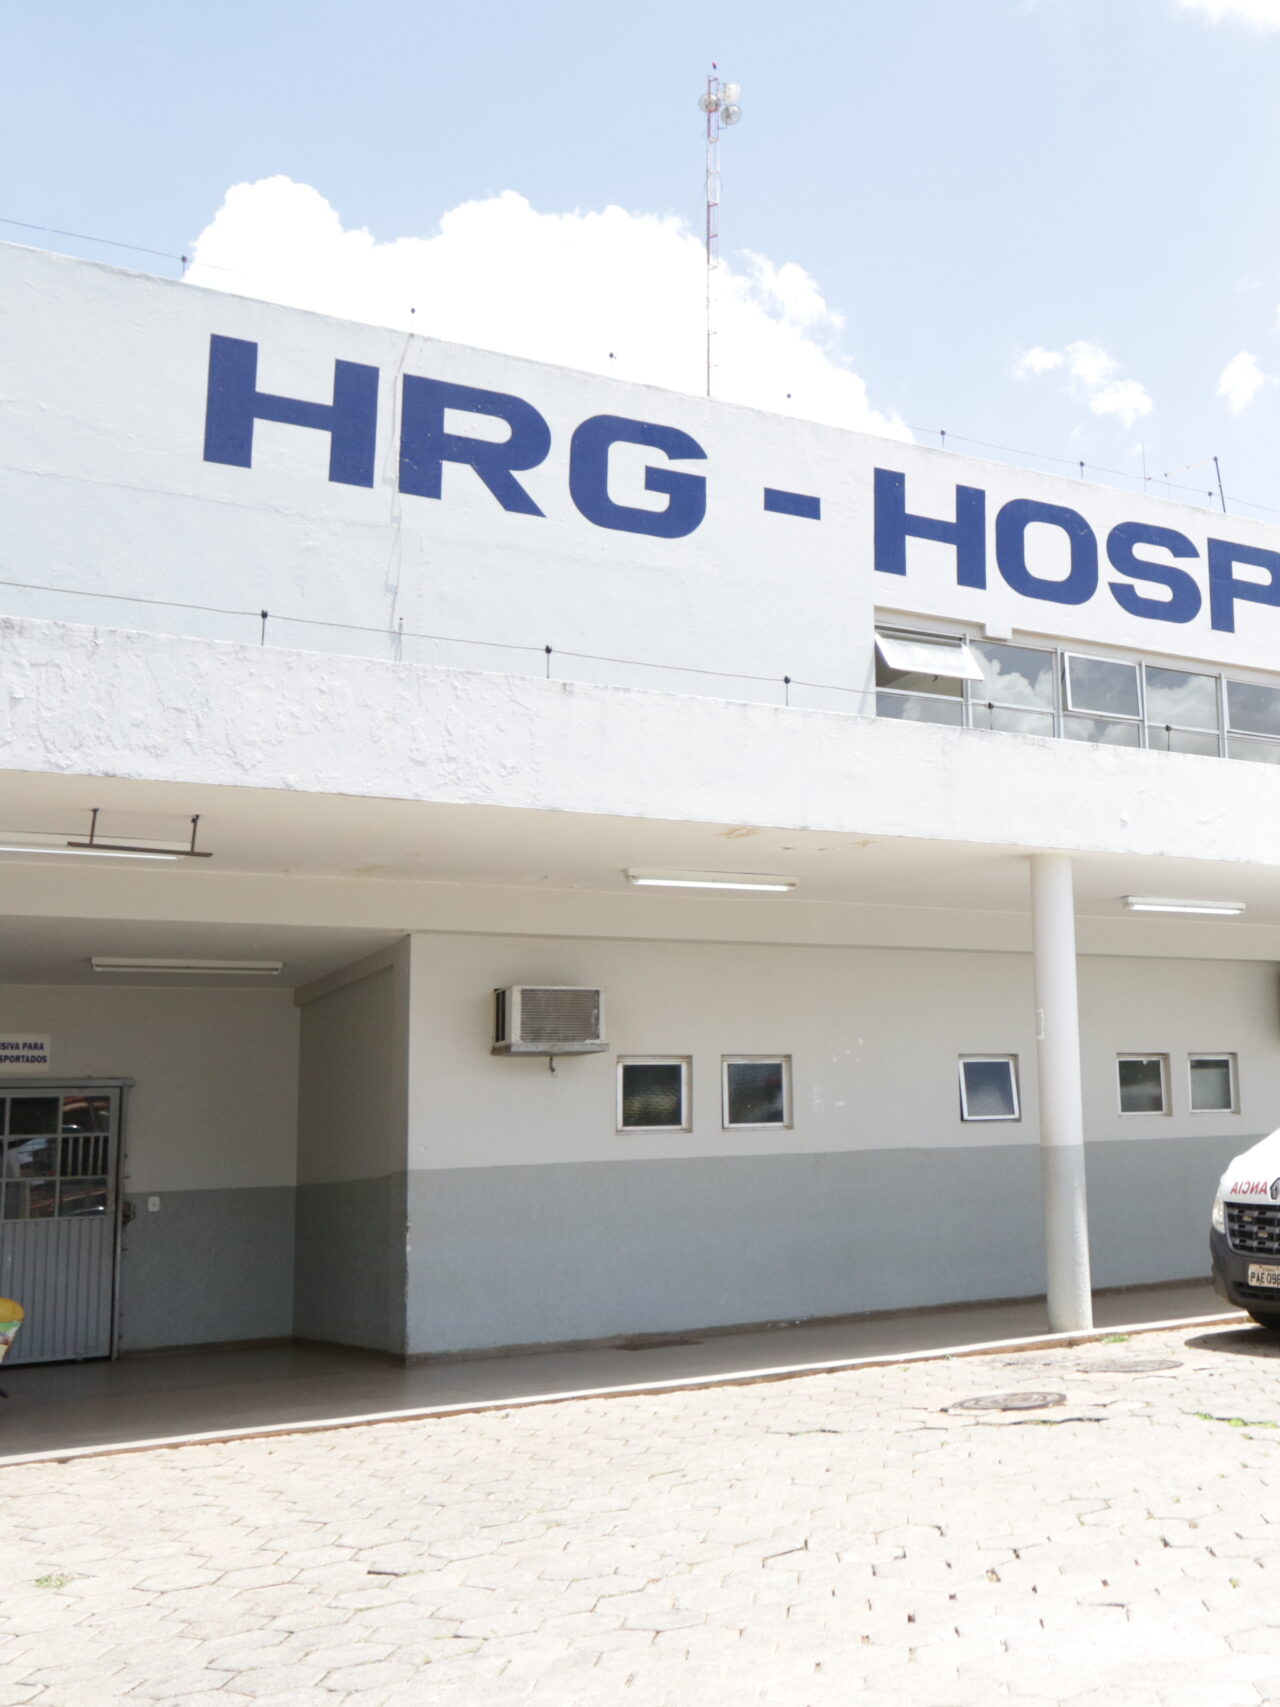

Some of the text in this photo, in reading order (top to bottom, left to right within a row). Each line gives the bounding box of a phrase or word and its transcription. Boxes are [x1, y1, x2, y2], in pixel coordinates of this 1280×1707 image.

[205, 335, 707, 539] HRG
[0, 1042, 44, 1050] SIVA PARA
[1250, 1271, 1265, 1284] PAE
